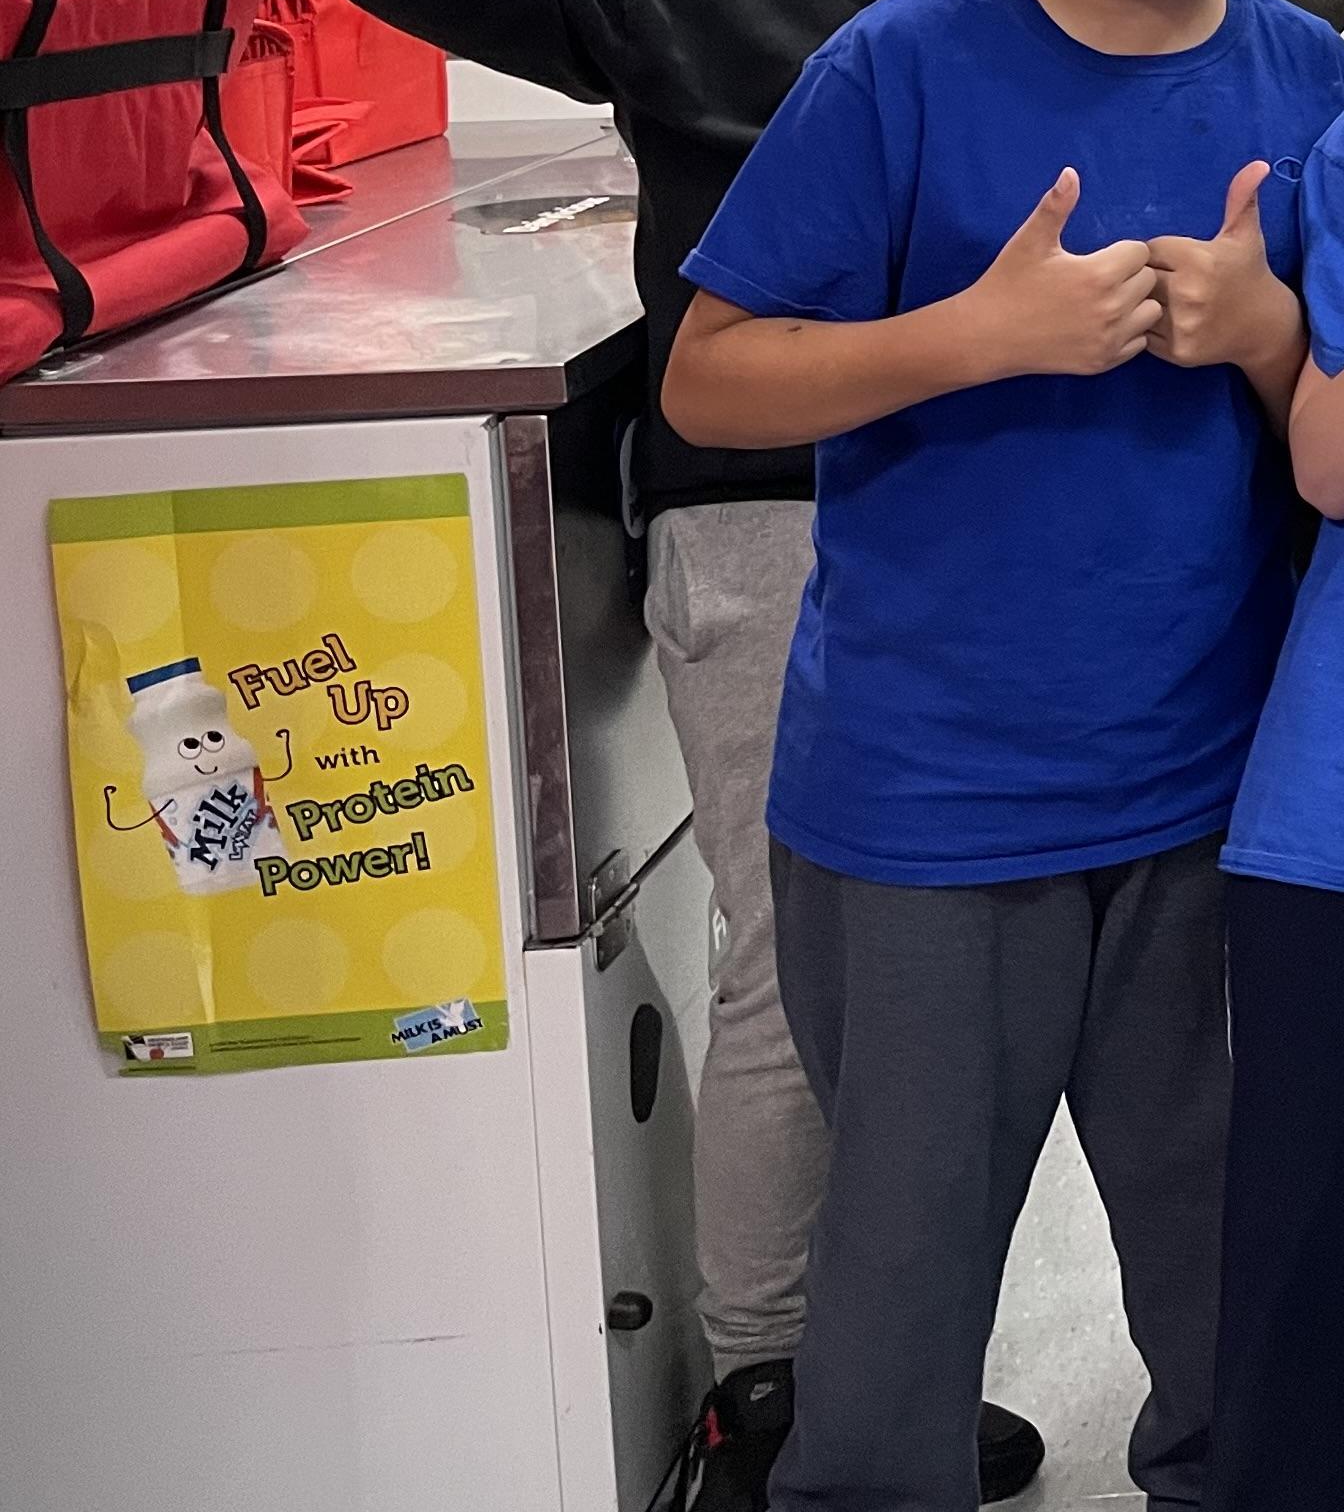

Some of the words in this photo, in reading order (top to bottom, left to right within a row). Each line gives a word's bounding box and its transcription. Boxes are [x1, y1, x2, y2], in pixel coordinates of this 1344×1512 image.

[227, 633, 357, 710] Fuel
[326, 680, 409, 731] Up
[314, 745, 381, 770] with
[191, 784, 247, 871] Milk
[286, 763, 475, 841] Protein
[254, 831, 431, 897] Power!
[391, 1022, 428, 1043] MILK
[427, 1018, 442, 1031] IS
[431, 1032, 442, 1043] A
[443, 1018, 483, 1039] MUST
